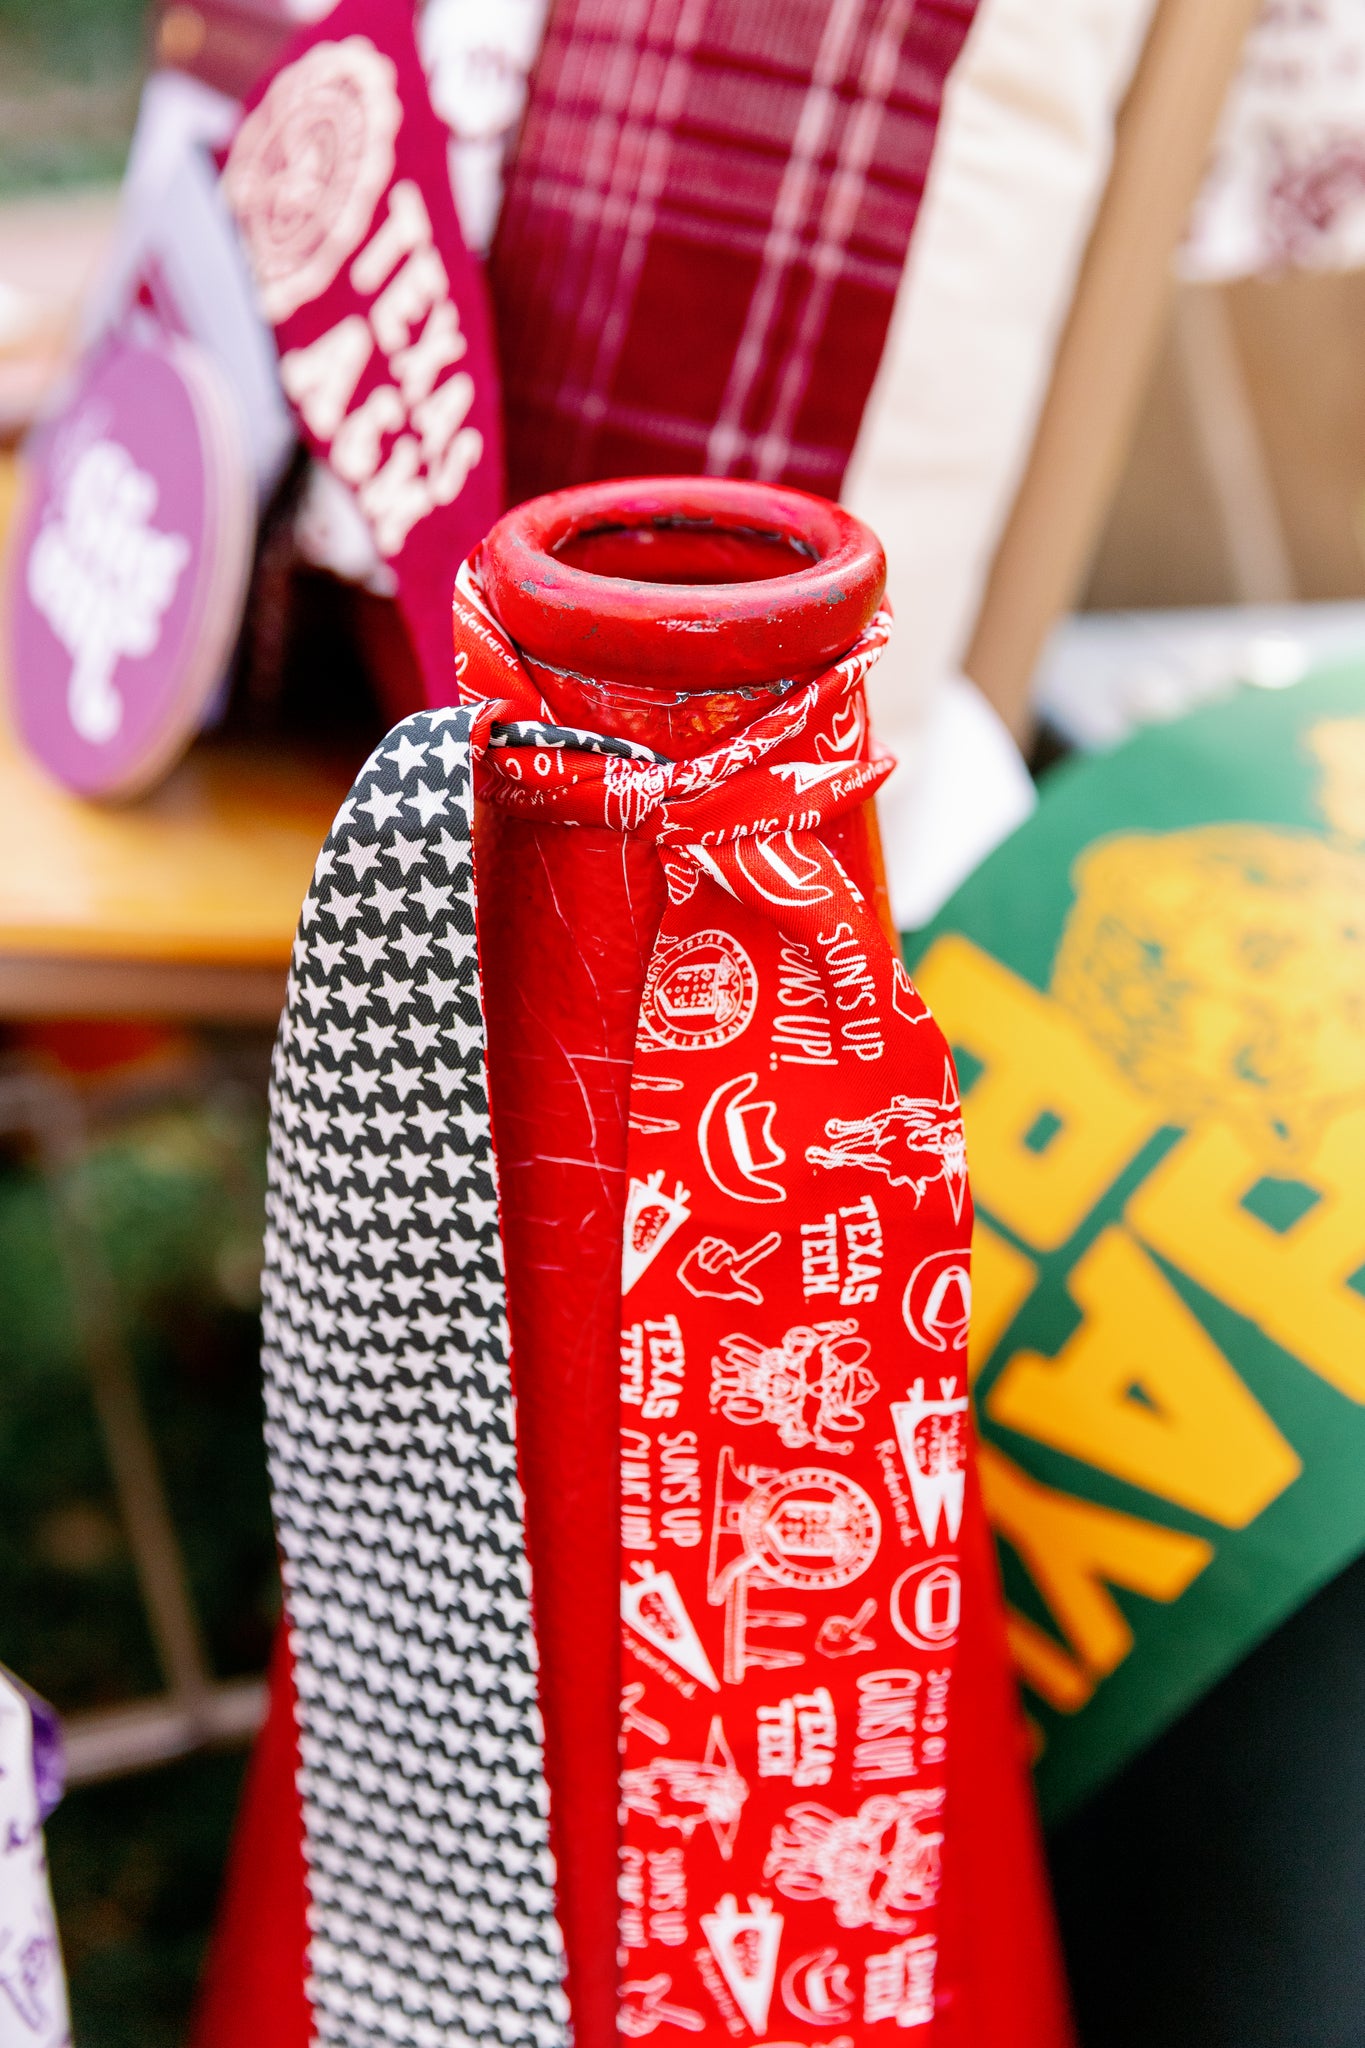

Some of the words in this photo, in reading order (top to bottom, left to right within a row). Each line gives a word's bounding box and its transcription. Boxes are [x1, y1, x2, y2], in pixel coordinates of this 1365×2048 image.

[350, 180, 484, 506] TEXAS
[818, 921, 877, 1011] SUN'S
[840, 1017, 886, 1062] UP
[800, 1213, 840, 1297] TECH
[837, 1196, 883, 1306] TEXAS
[641, 1314, 685, 1419] TEXAS
[657, 1507, 703, 1548] UP
[794, 1687, 837, 1787] TEXAS
